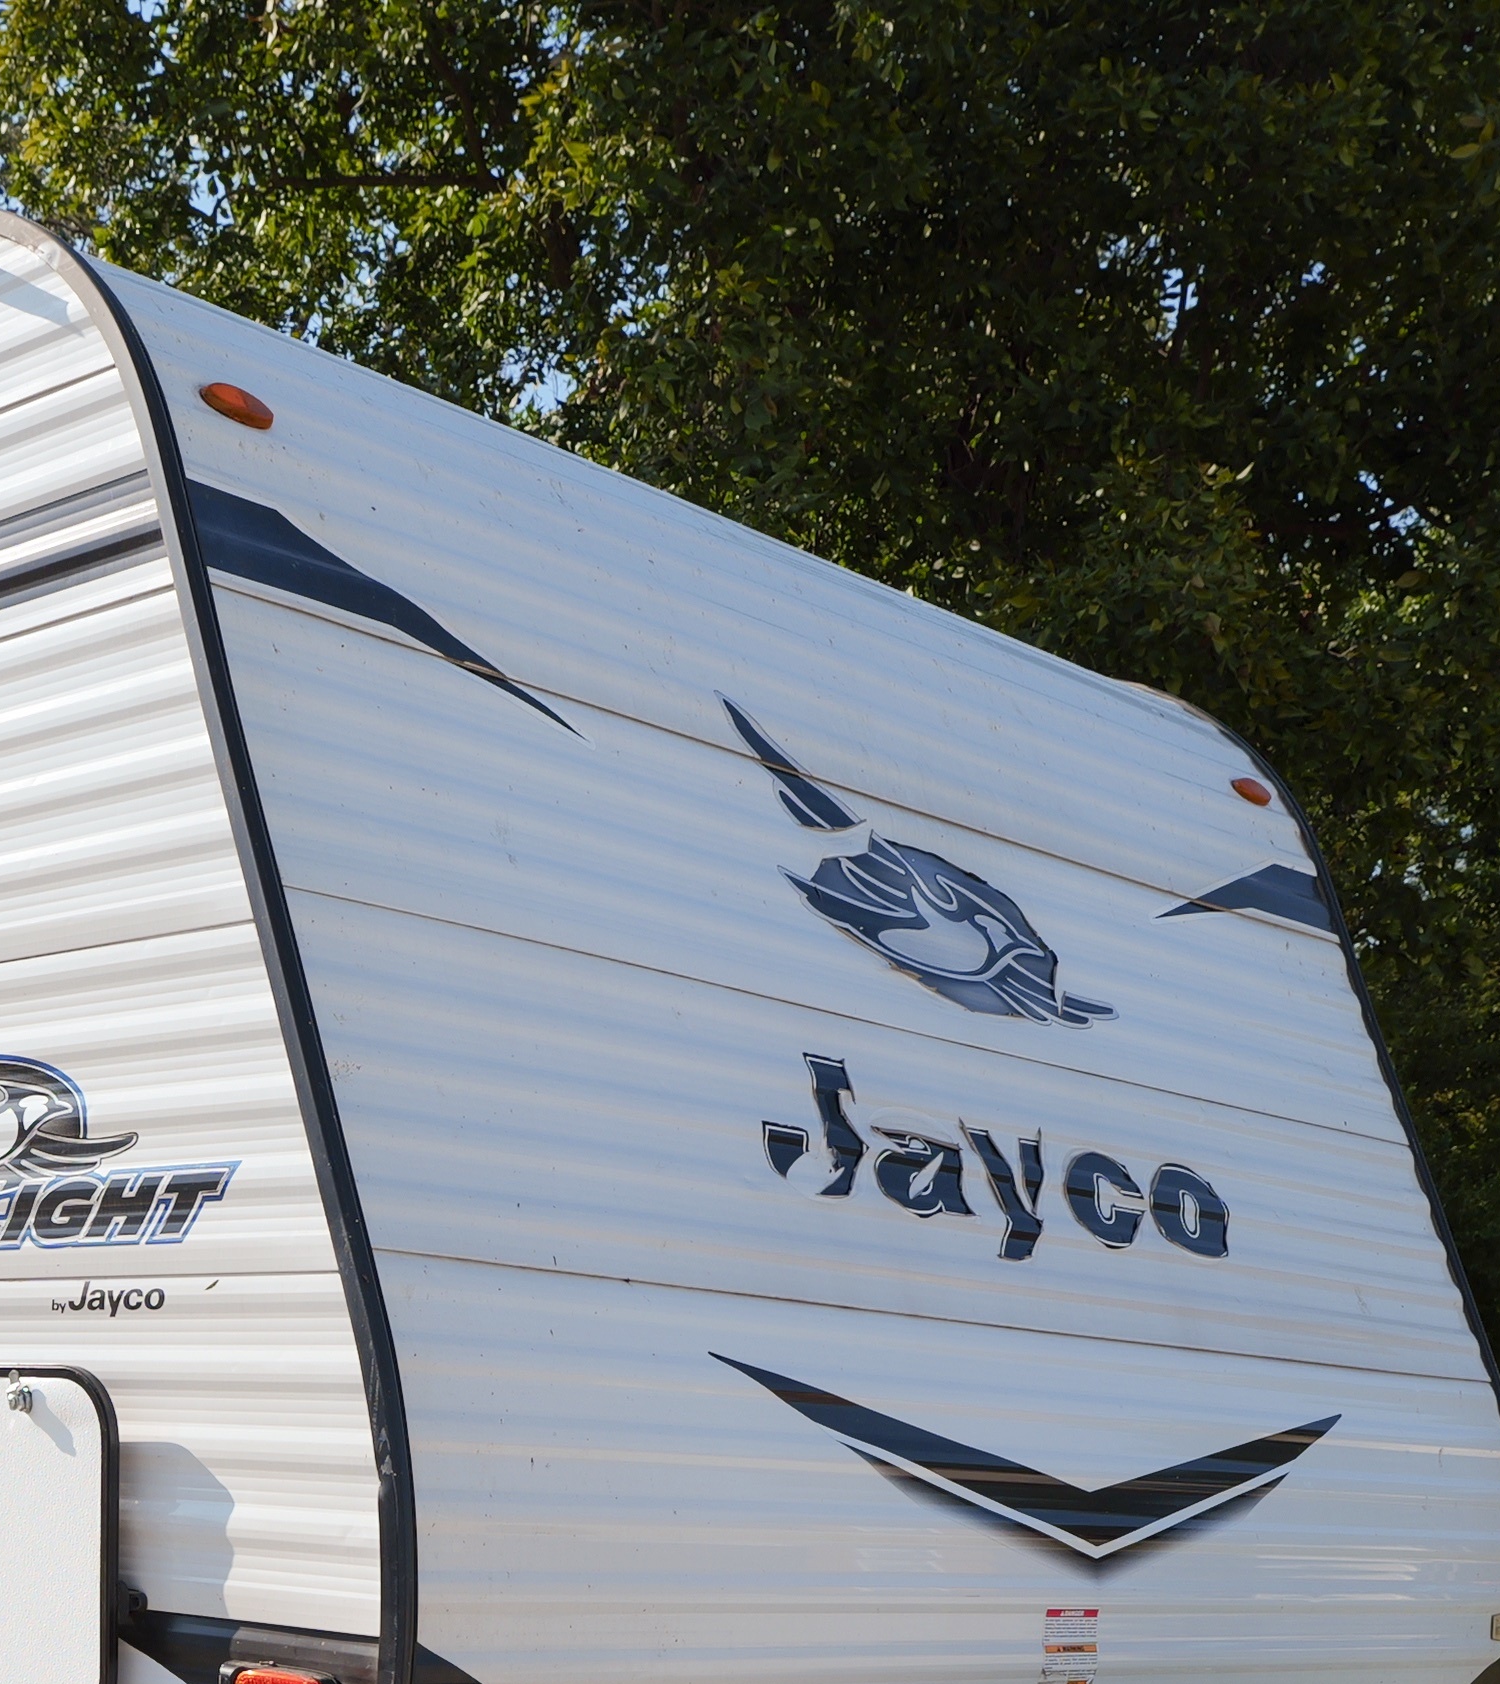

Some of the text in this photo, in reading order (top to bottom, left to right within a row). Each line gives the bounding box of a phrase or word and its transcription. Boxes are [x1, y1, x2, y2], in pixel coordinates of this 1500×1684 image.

[761, 1053, 1229, 1261] Jayco
[51, 1281, 165, 1317] by Jayco
